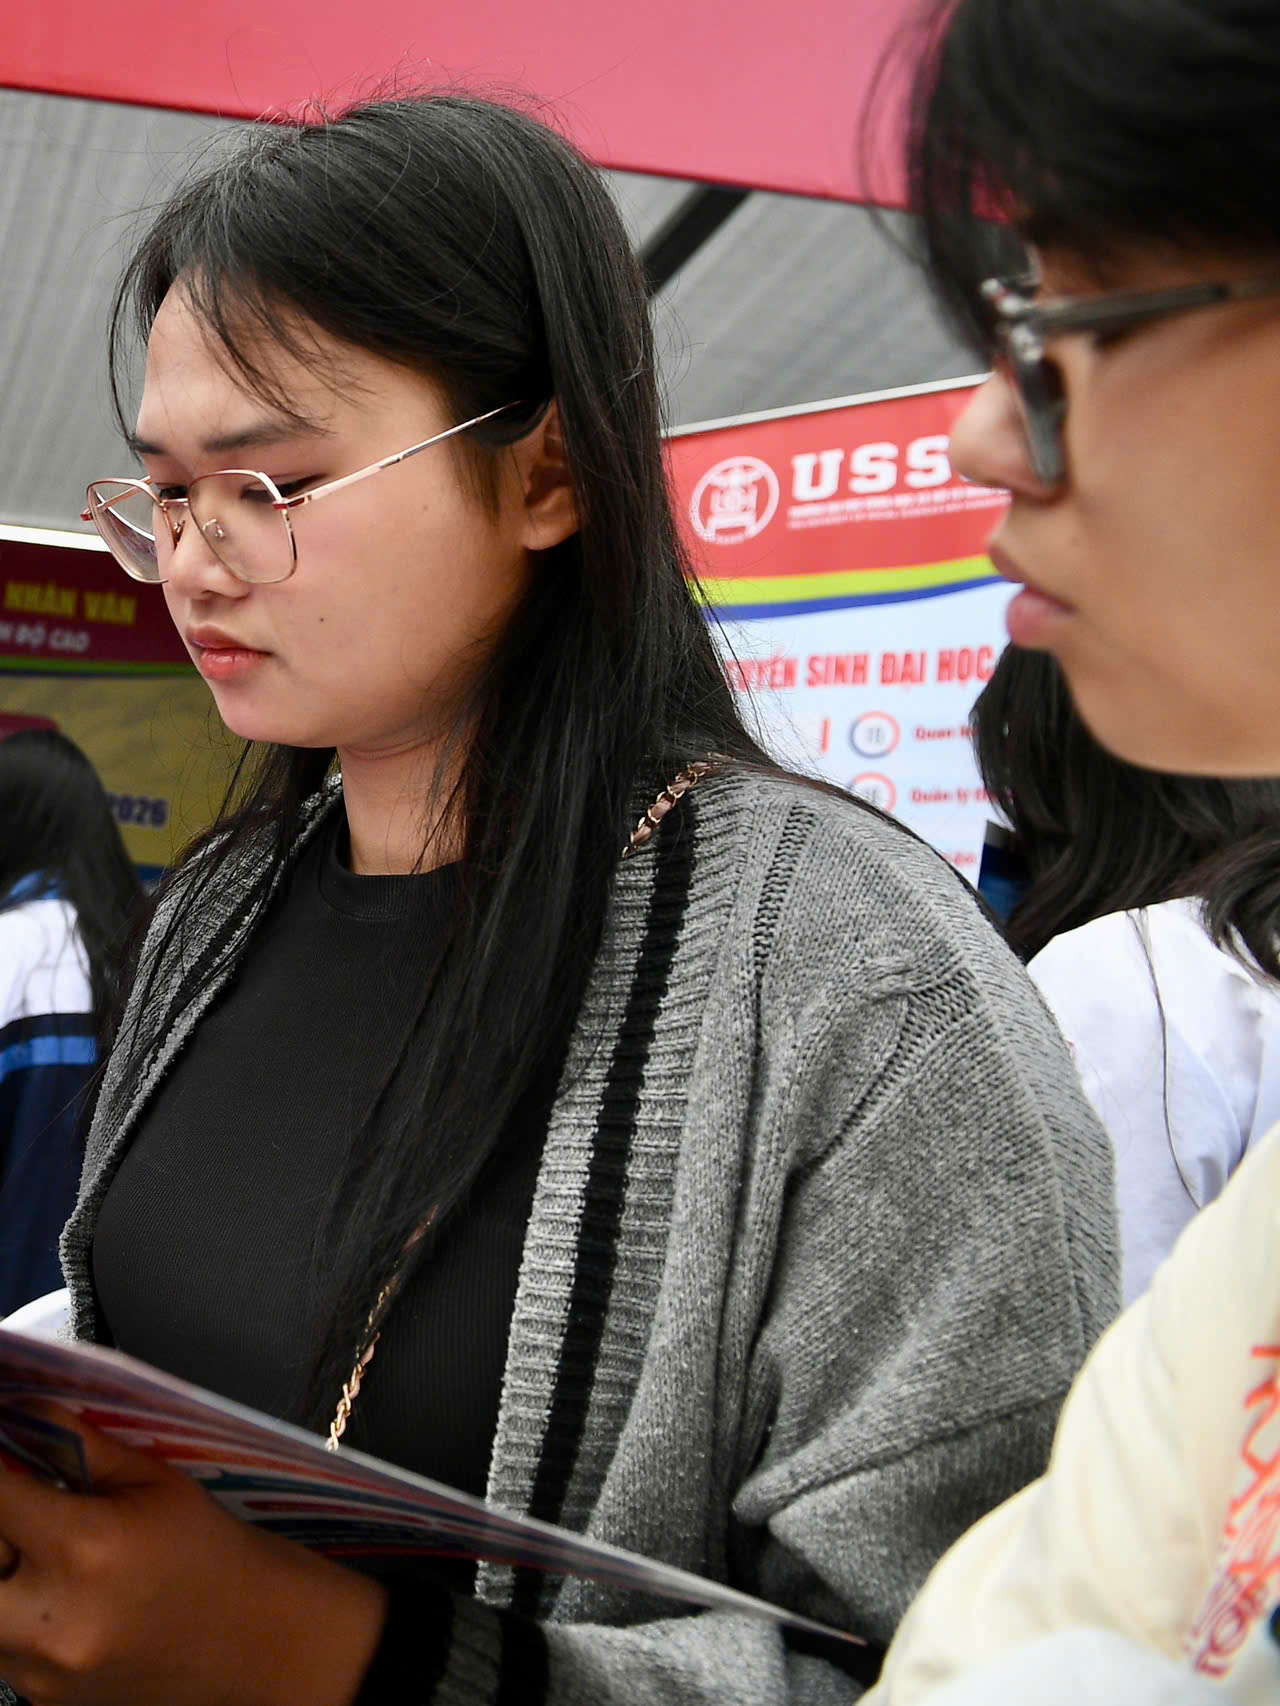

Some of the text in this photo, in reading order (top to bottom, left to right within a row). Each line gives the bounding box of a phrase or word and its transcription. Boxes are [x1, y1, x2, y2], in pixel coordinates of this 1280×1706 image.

[790, 433, 956, 502] USS
[49, 628, 90, 653] CAO
[805, 652, 871, 689] SINH
[880, 650, 928, 691] ĐẠI
[936, 645, 995, 691] HỌC
